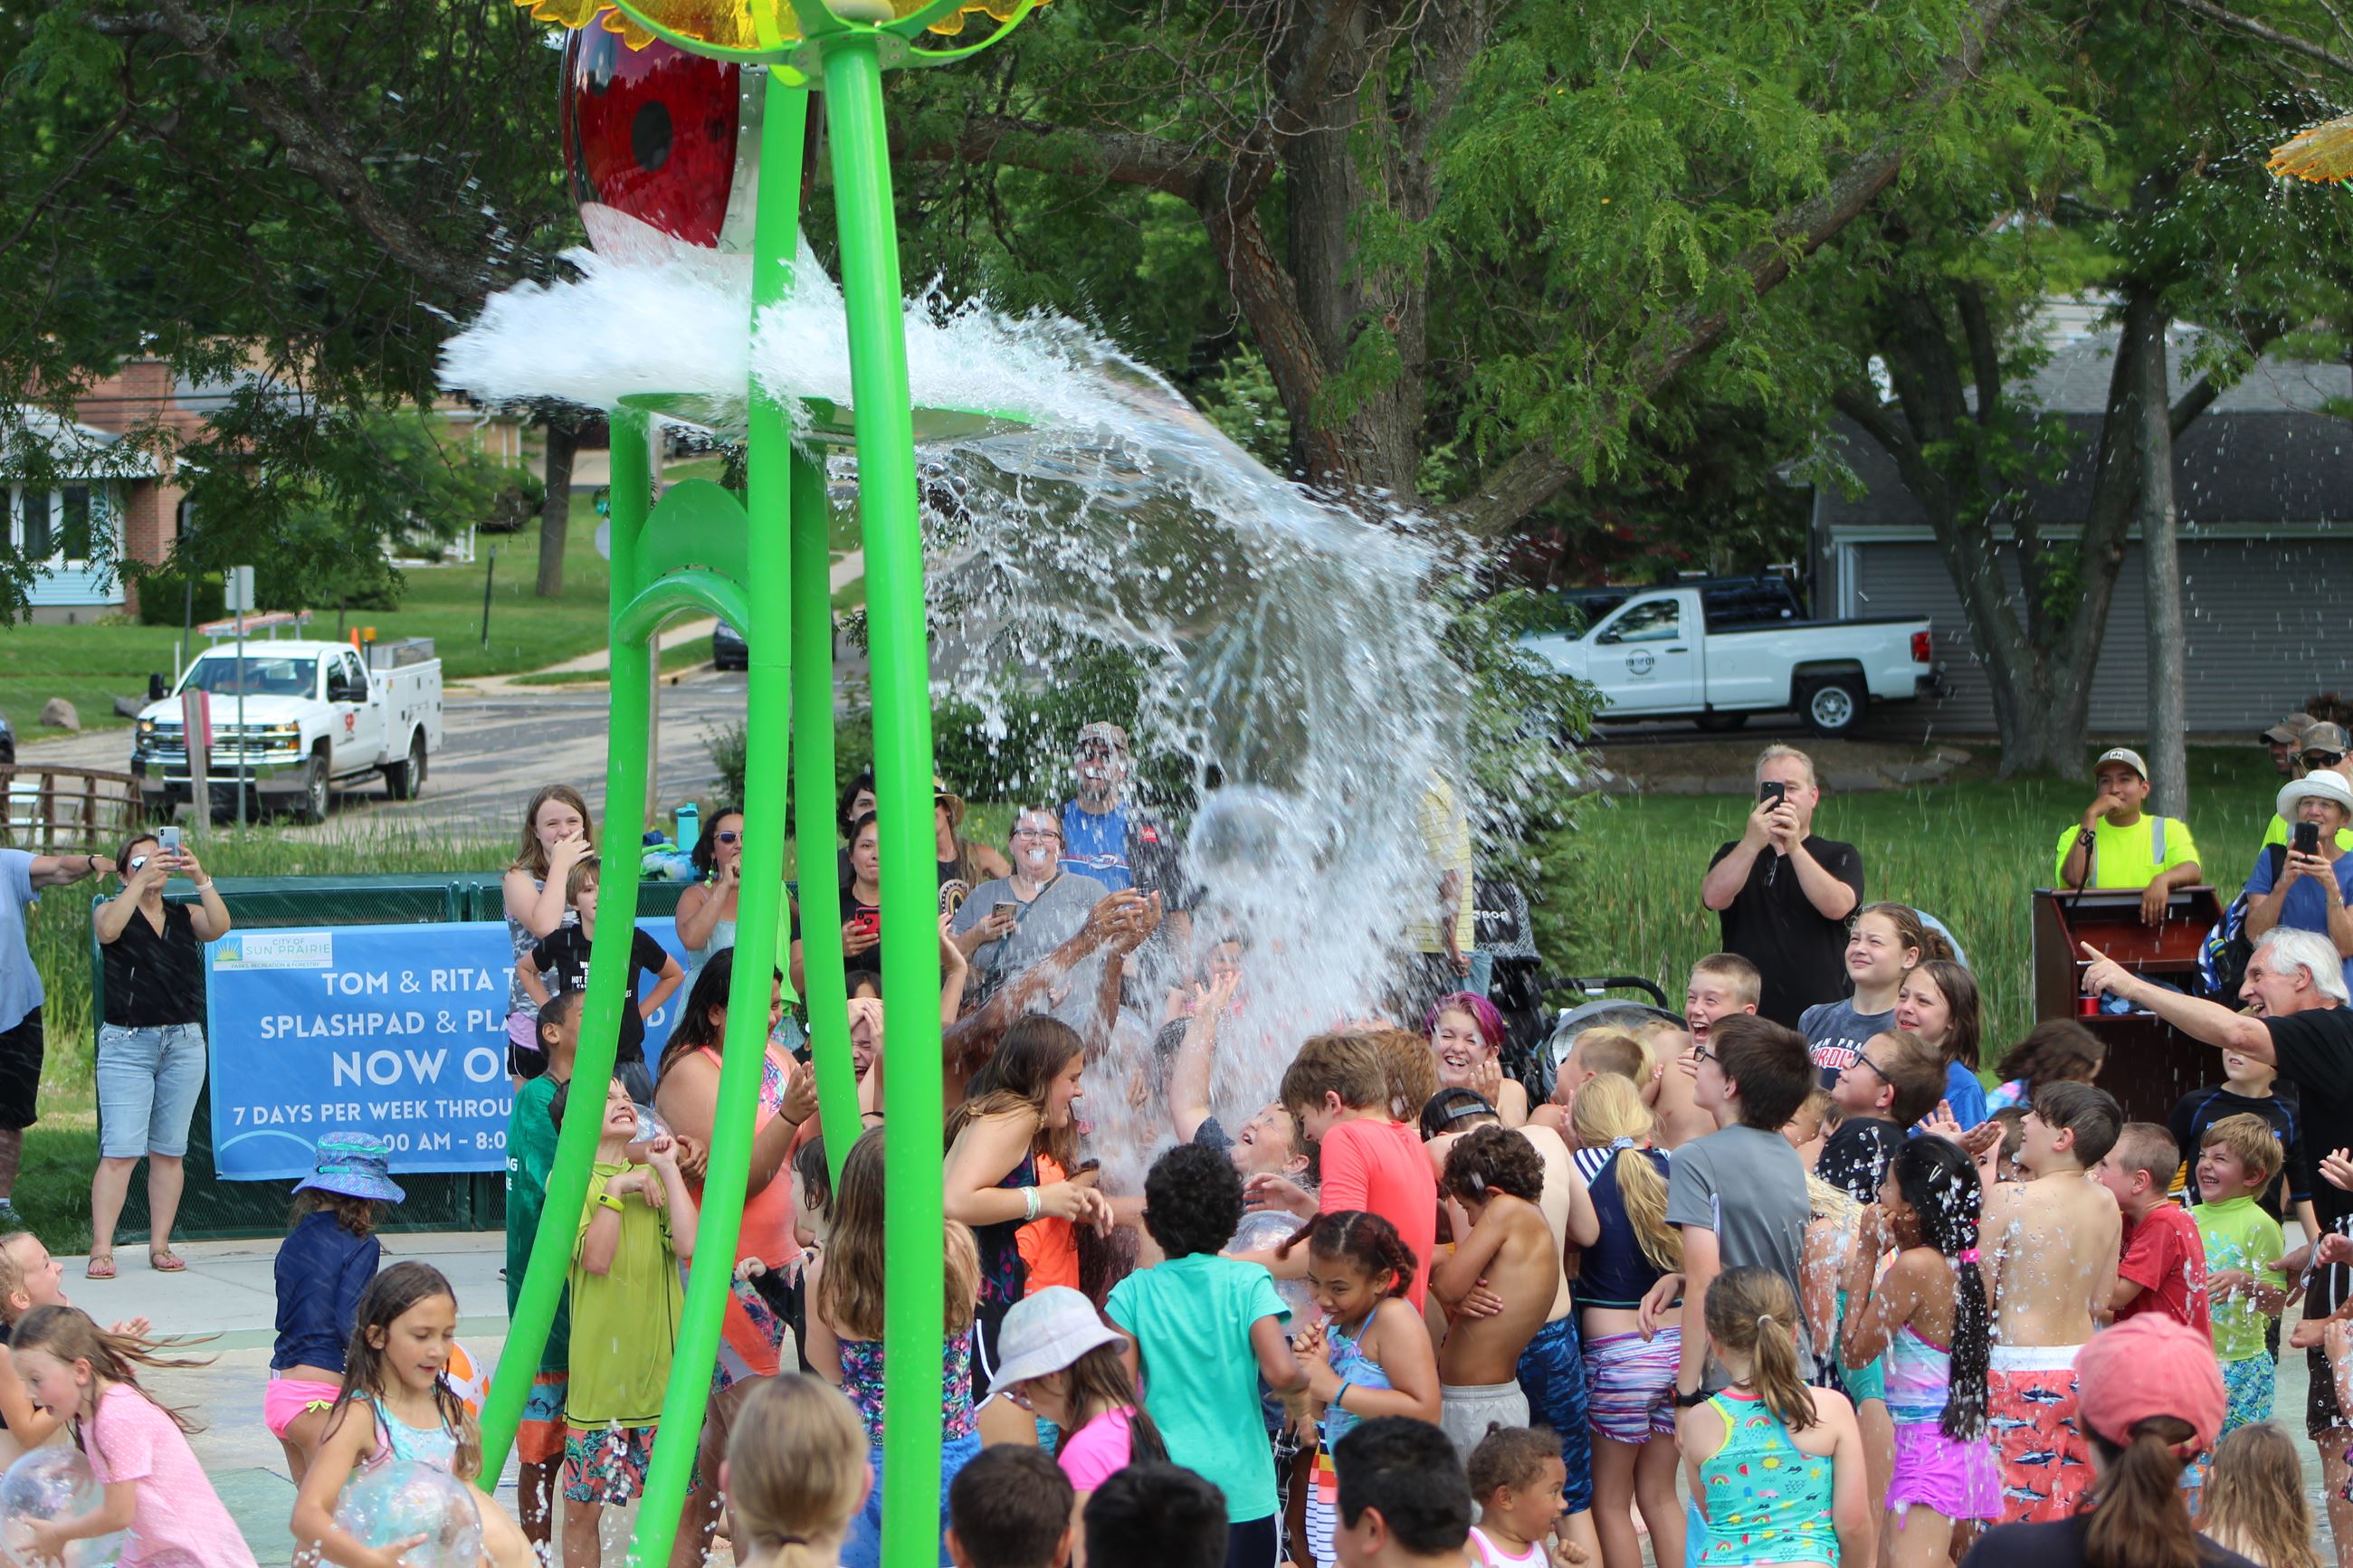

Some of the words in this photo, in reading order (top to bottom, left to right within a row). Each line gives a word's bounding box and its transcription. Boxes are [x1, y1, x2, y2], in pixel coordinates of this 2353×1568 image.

[245, 946, 272, 955] SUN
[278, 944, 331, 955] PRAIRIE
[272, 938, 291, 946] CITY
[294, 937, 305, 946] OF
[321, 971, 388, 995] TOM
[399, 970, 421, 993] &
[431, 968, 494, 993] RITA
[571, 976, 583, 984] HOT
[260, 1012, 425, 1039] SPLASHPAD
[435, 1010, 457, 1033] &
[332, 1049, 448, 1087] NOW
[233, 1107, 246, 1126] 7
[252, 1105, 313, 1125] DAYS
[320, 1103, 361, 1122] PER
[367, 1100, 429, 1120] WEEK
[417, 1132, 451, 1151] AM
